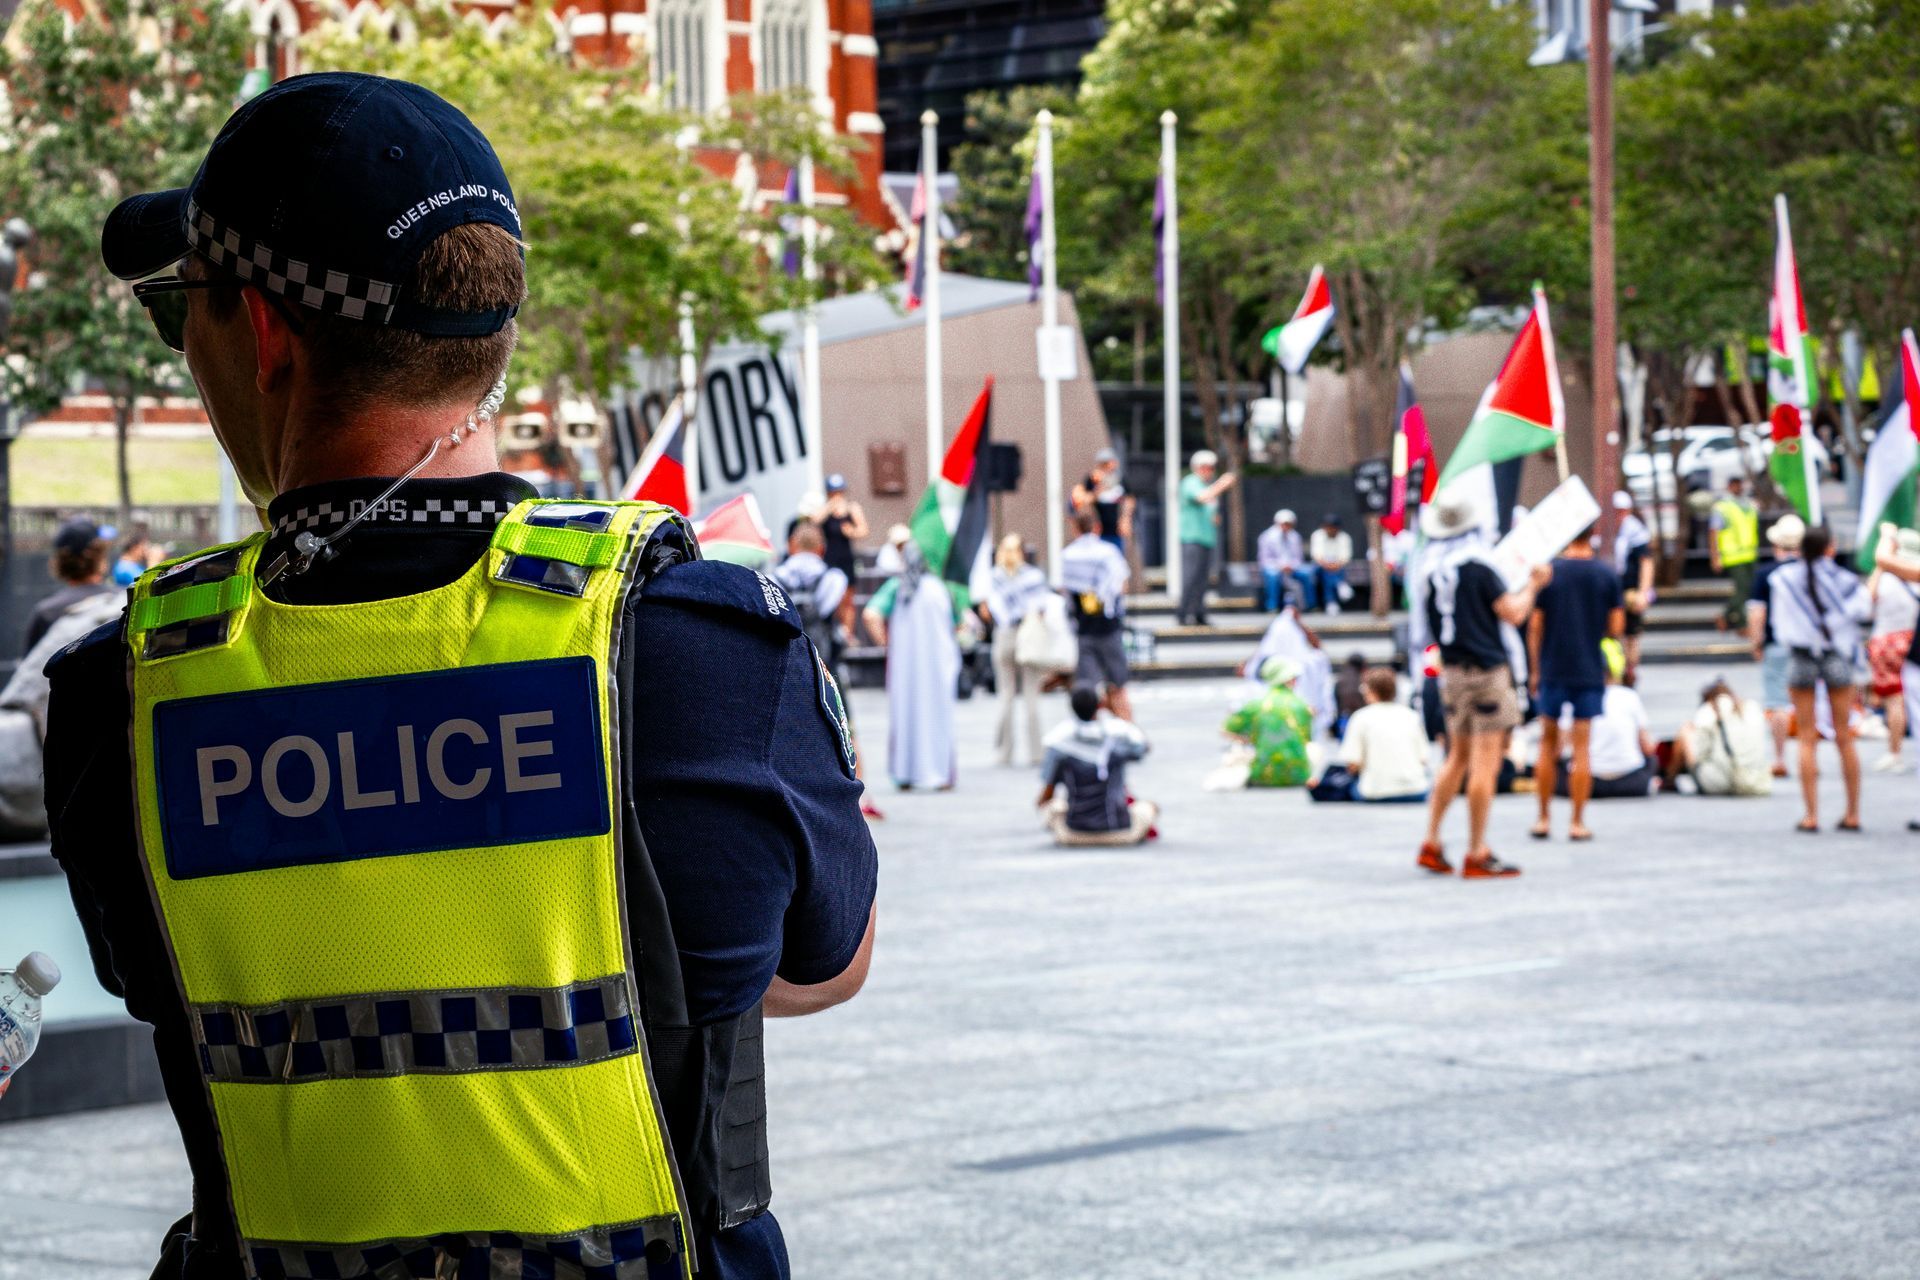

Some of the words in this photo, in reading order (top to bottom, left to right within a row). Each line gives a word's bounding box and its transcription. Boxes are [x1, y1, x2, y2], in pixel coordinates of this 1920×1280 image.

[386, 184, 488, 240] QUEENSLAND
[607, 351, 807, 492] IORY
[349, 499, 407, 521] QPS
[196, 709, 562, 826] POLICE
